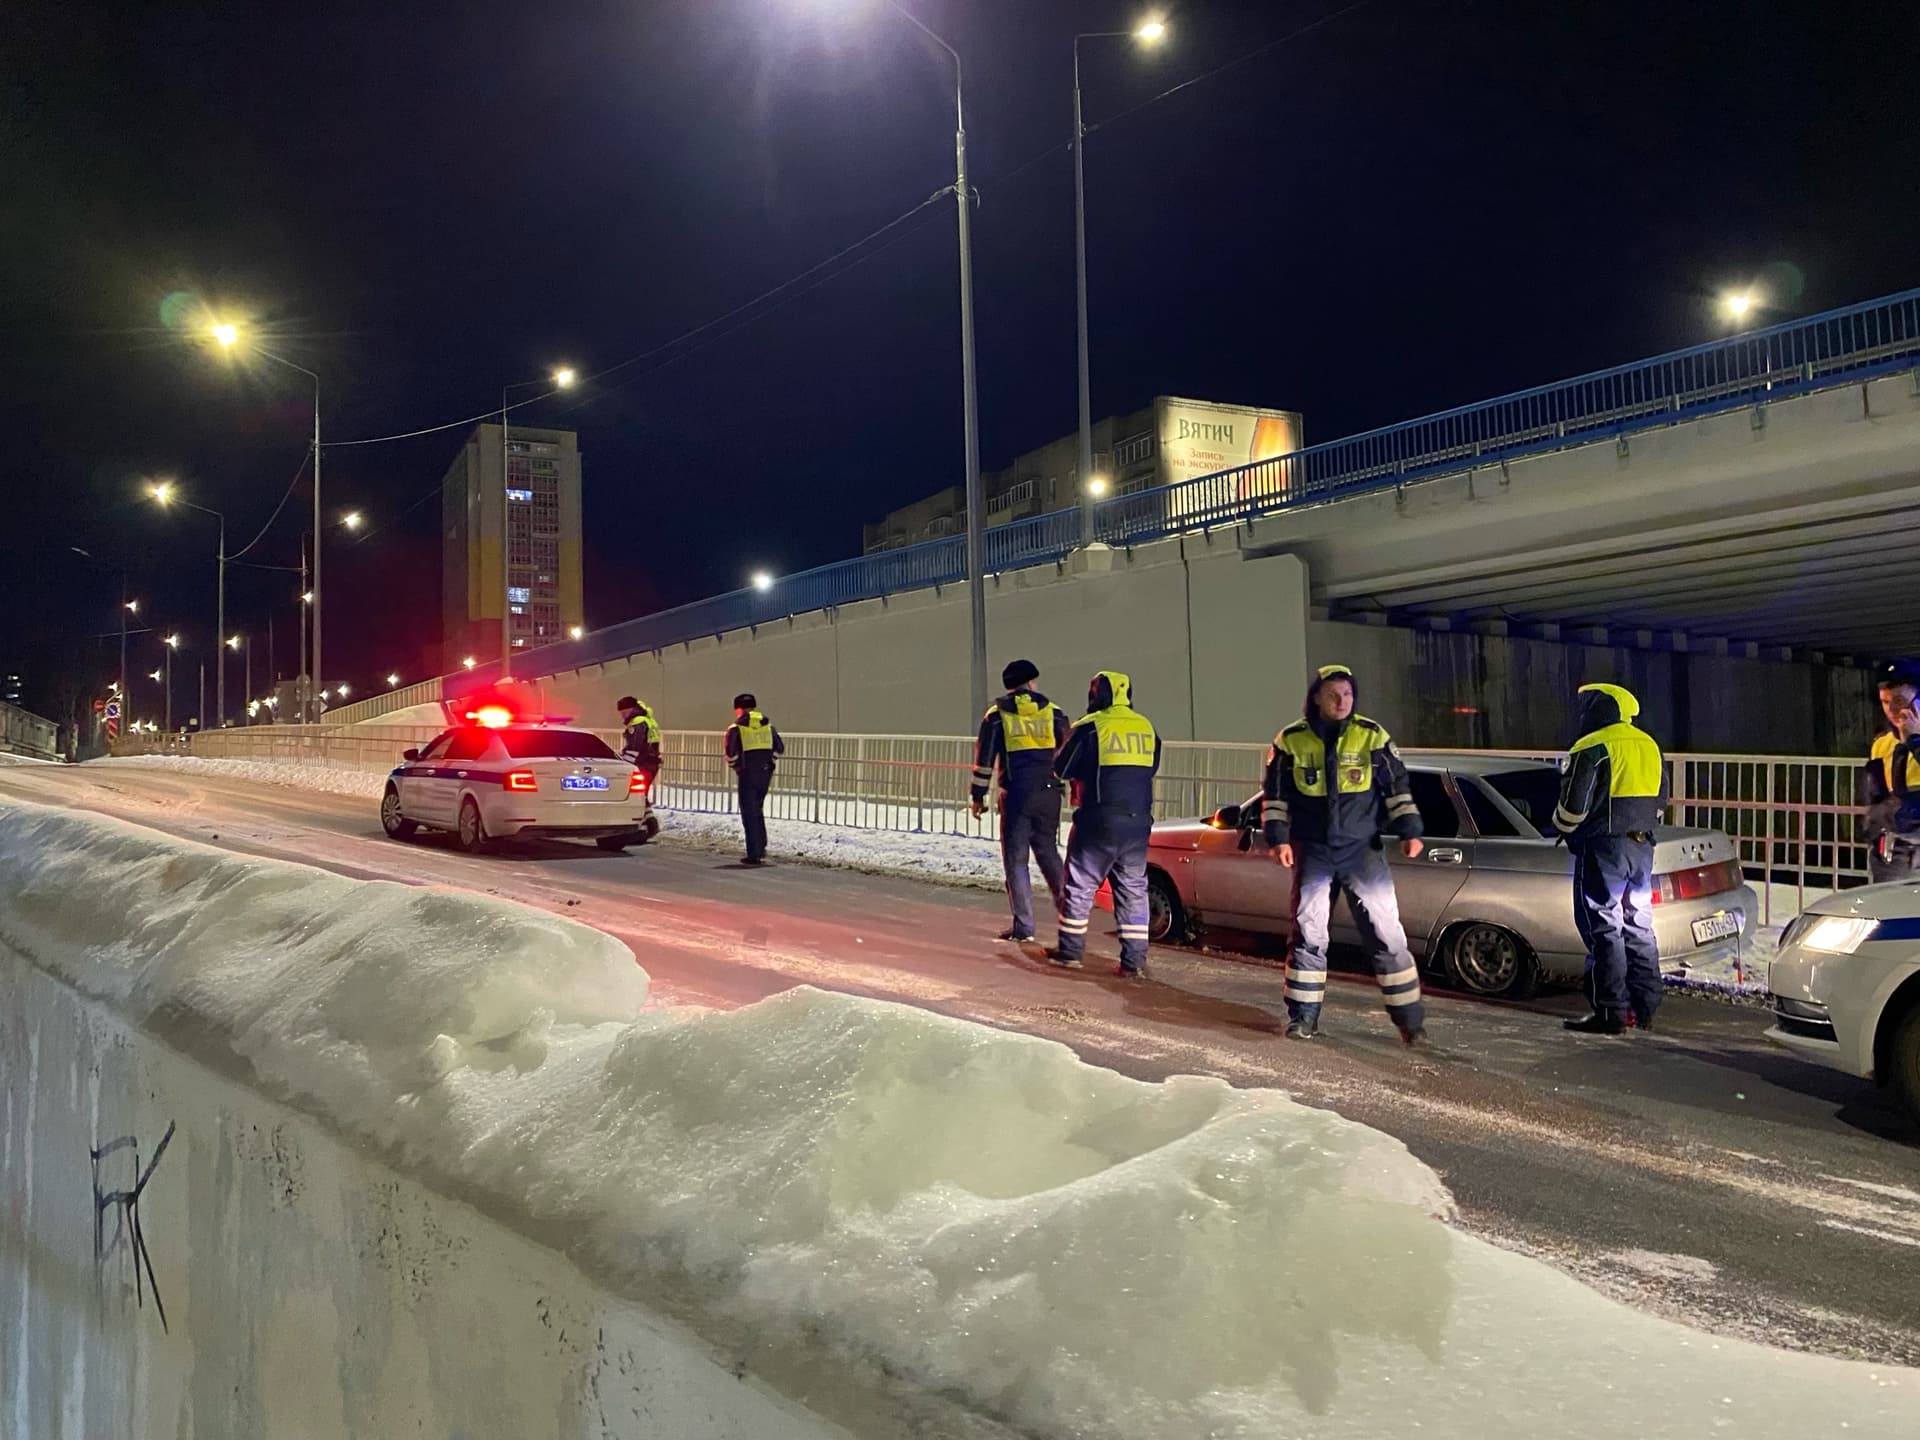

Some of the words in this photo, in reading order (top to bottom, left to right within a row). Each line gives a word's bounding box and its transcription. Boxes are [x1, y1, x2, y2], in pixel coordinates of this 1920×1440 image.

[1179, 418, 1233, 444] ВЯТИЧ
[1173, 458, 1185, 467] на
[1190, 448, 1225, 461] Запись
[1107, 731, 1153, 754] ДПС
